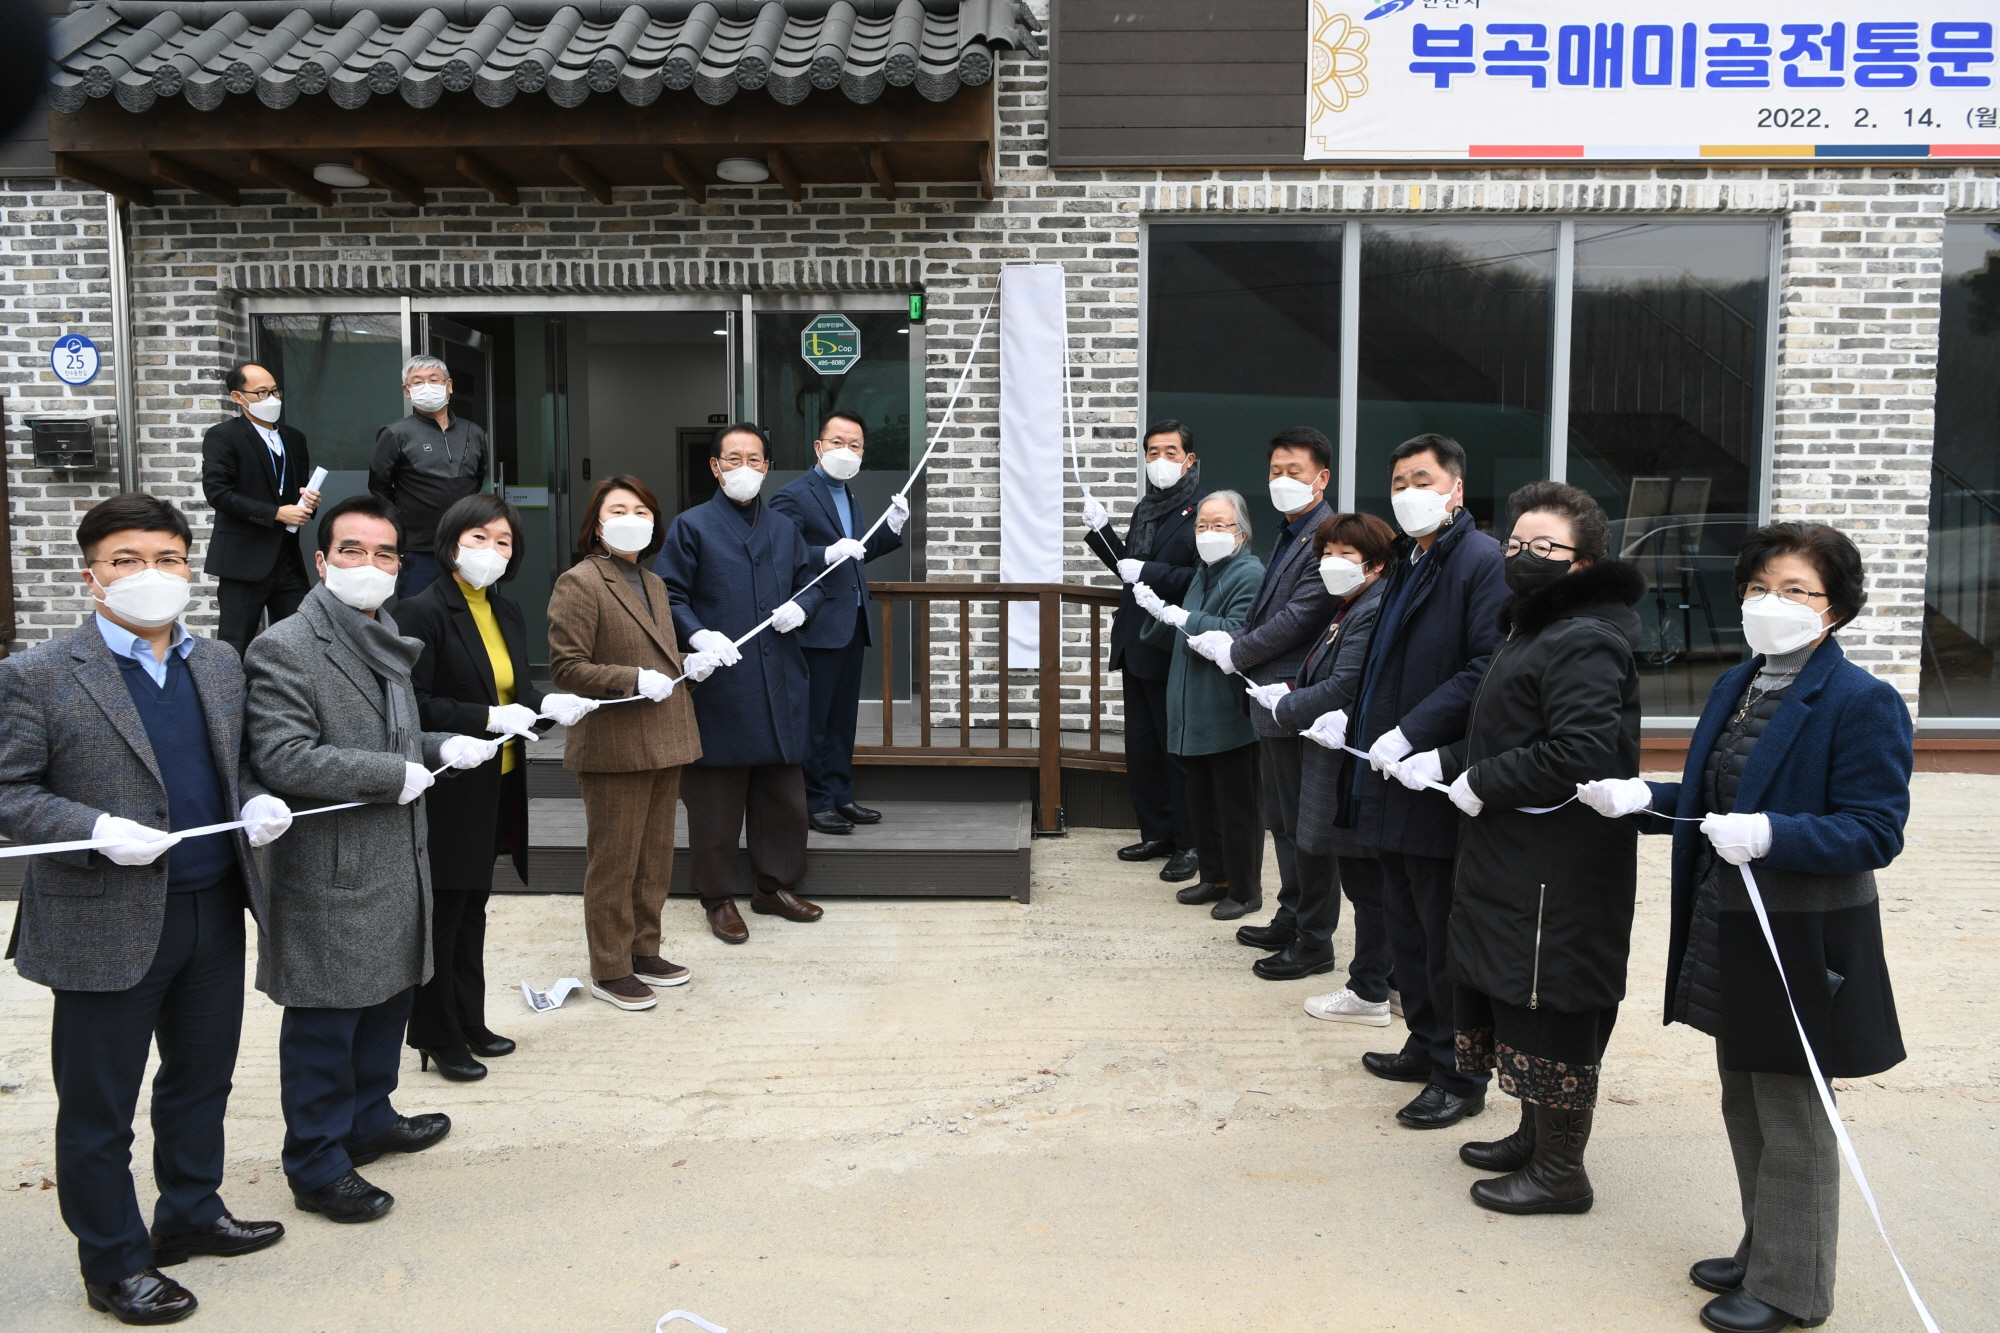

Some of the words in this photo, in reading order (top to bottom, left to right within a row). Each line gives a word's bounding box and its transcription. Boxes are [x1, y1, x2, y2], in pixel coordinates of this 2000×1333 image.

[1409, 22, 1995, 88] 부곡매미골전통문
[1757, 107, 1830, 129] 2022.
[1854, 107, 1878, 129] 2.
[1904, 107, 1942, 129] 14.
[1966, 106, 2000, 130] (월
[66, 355, 84, 369] 25
